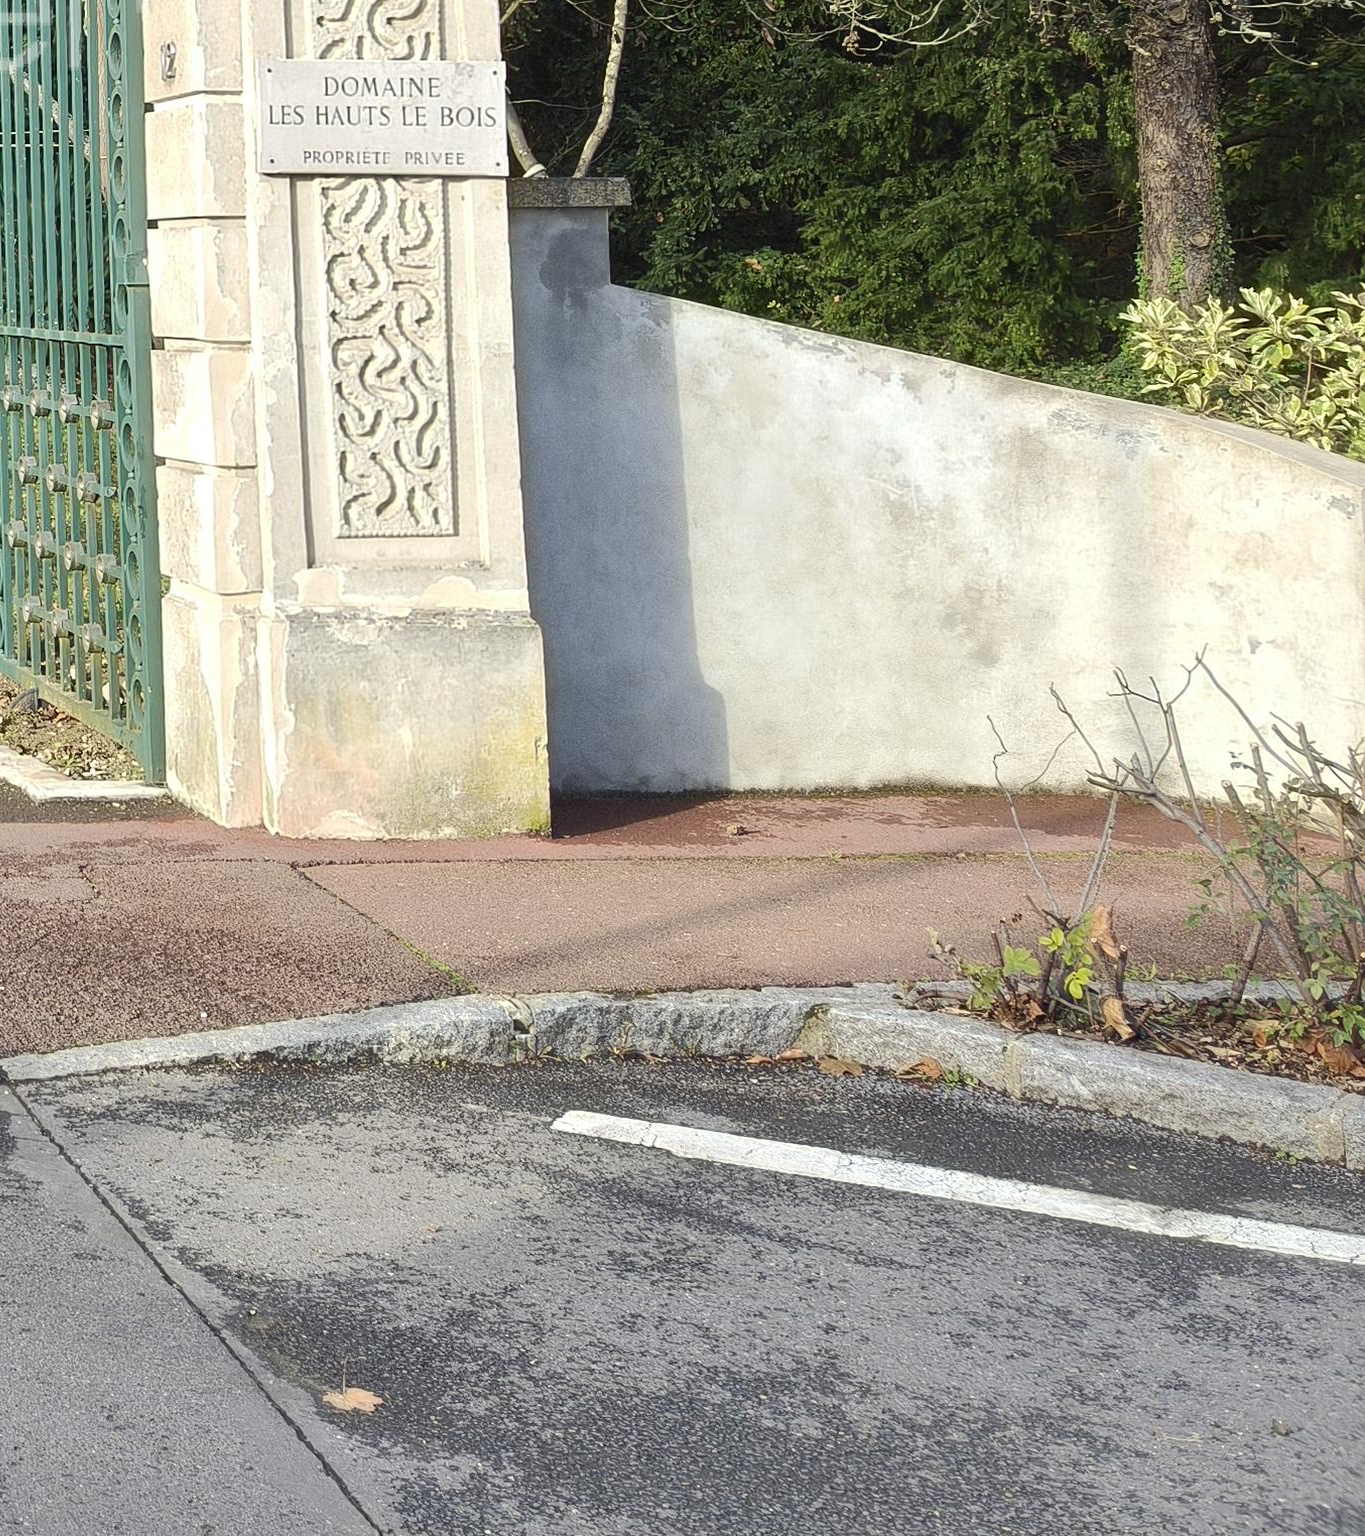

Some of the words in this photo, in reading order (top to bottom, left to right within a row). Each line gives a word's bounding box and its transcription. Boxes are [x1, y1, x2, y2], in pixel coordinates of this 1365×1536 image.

[160, 41, 177, 82] 12
[324, 76, 441, 98] DOMAINE
[269, 104, 305, 126] LES
[315, 106, 391, 127] HAUTS
[402, 106, 428, 127] LE
[440, 107, 498, 128] BOIS
[303, 150, 391, 165] PROPRIETE
[404, 151, 466, 166] PRIVEE
